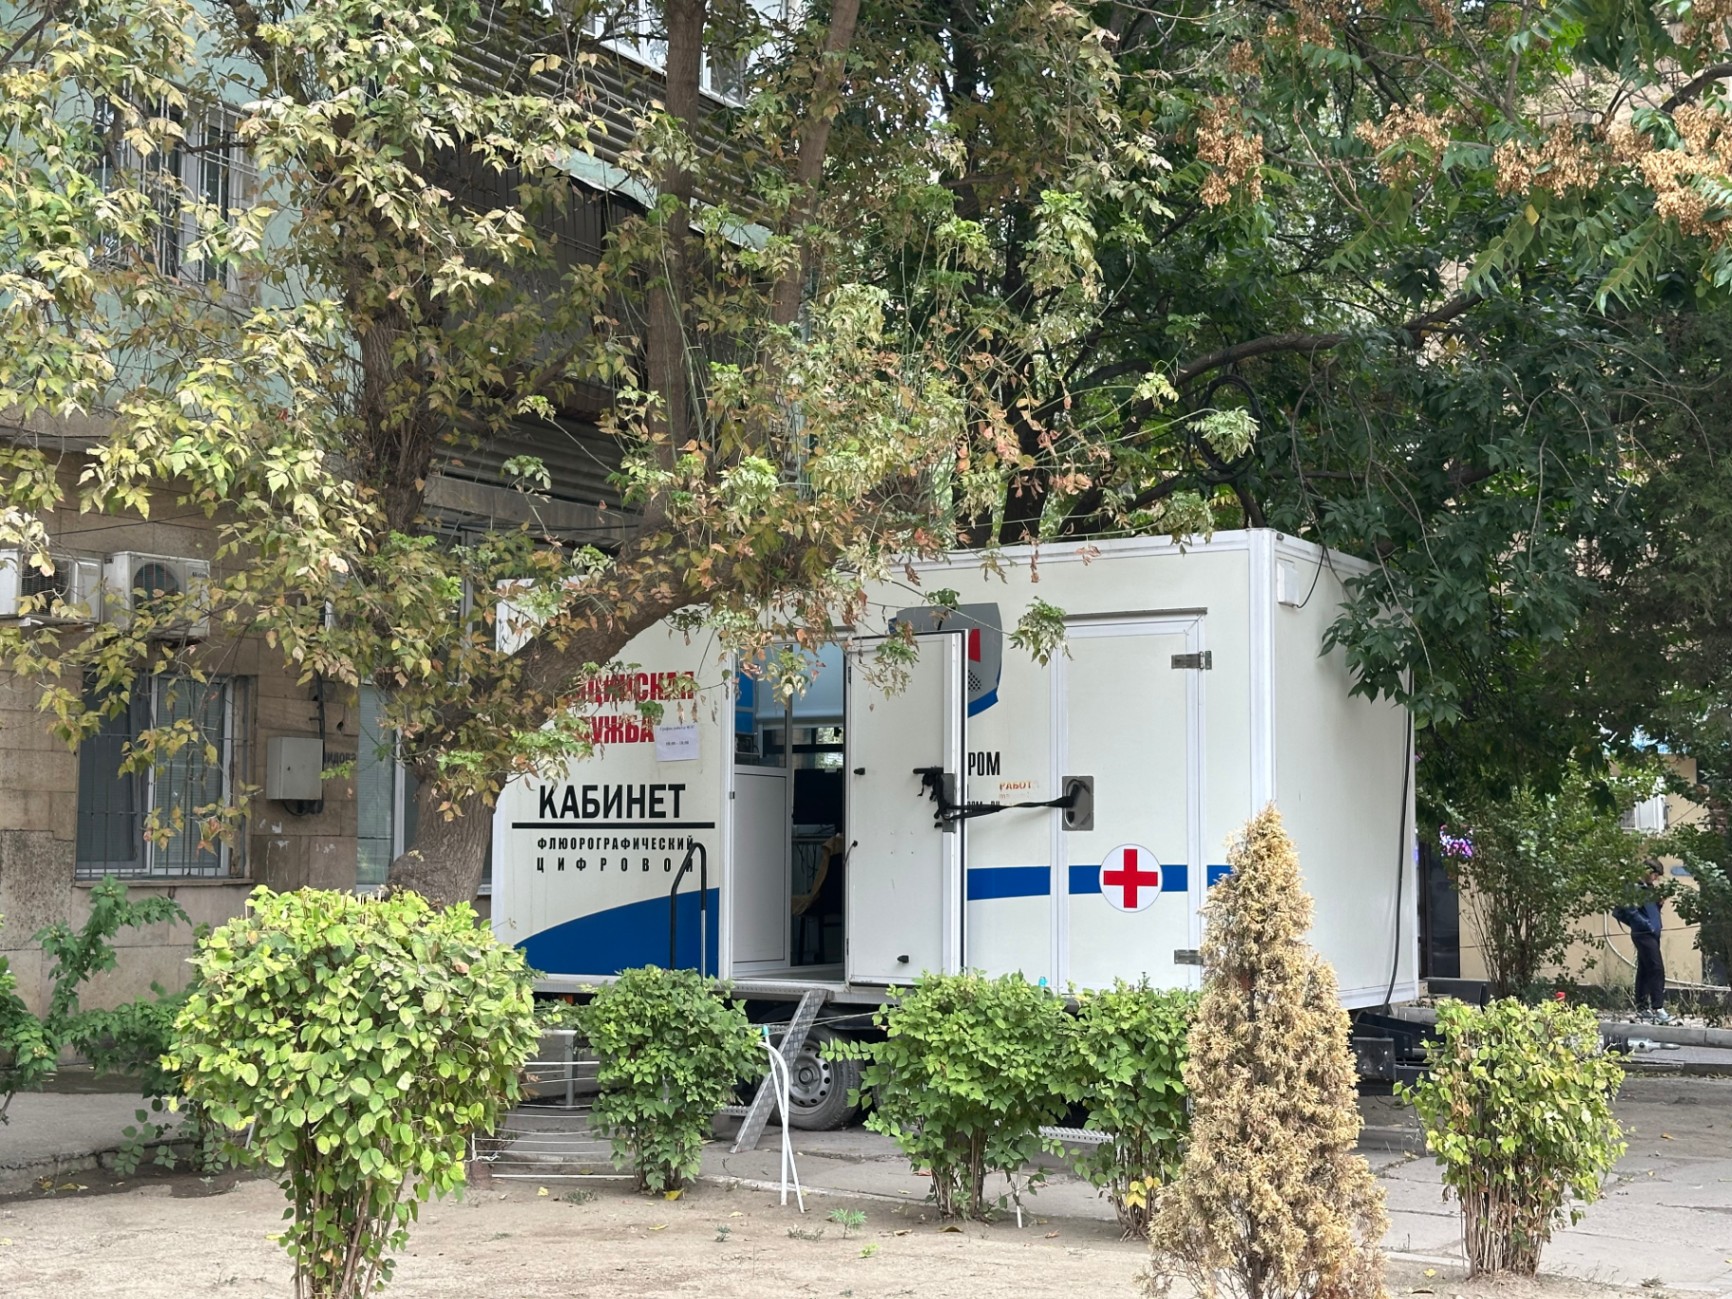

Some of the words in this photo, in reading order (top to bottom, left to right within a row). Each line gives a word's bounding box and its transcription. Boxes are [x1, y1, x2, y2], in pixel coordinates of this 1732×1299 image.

[582, 714, 654, 744] УЖБА
[967, 751, 1001, 776] РОМ
[539, 784, 686, 819] КАБИНЕТ
